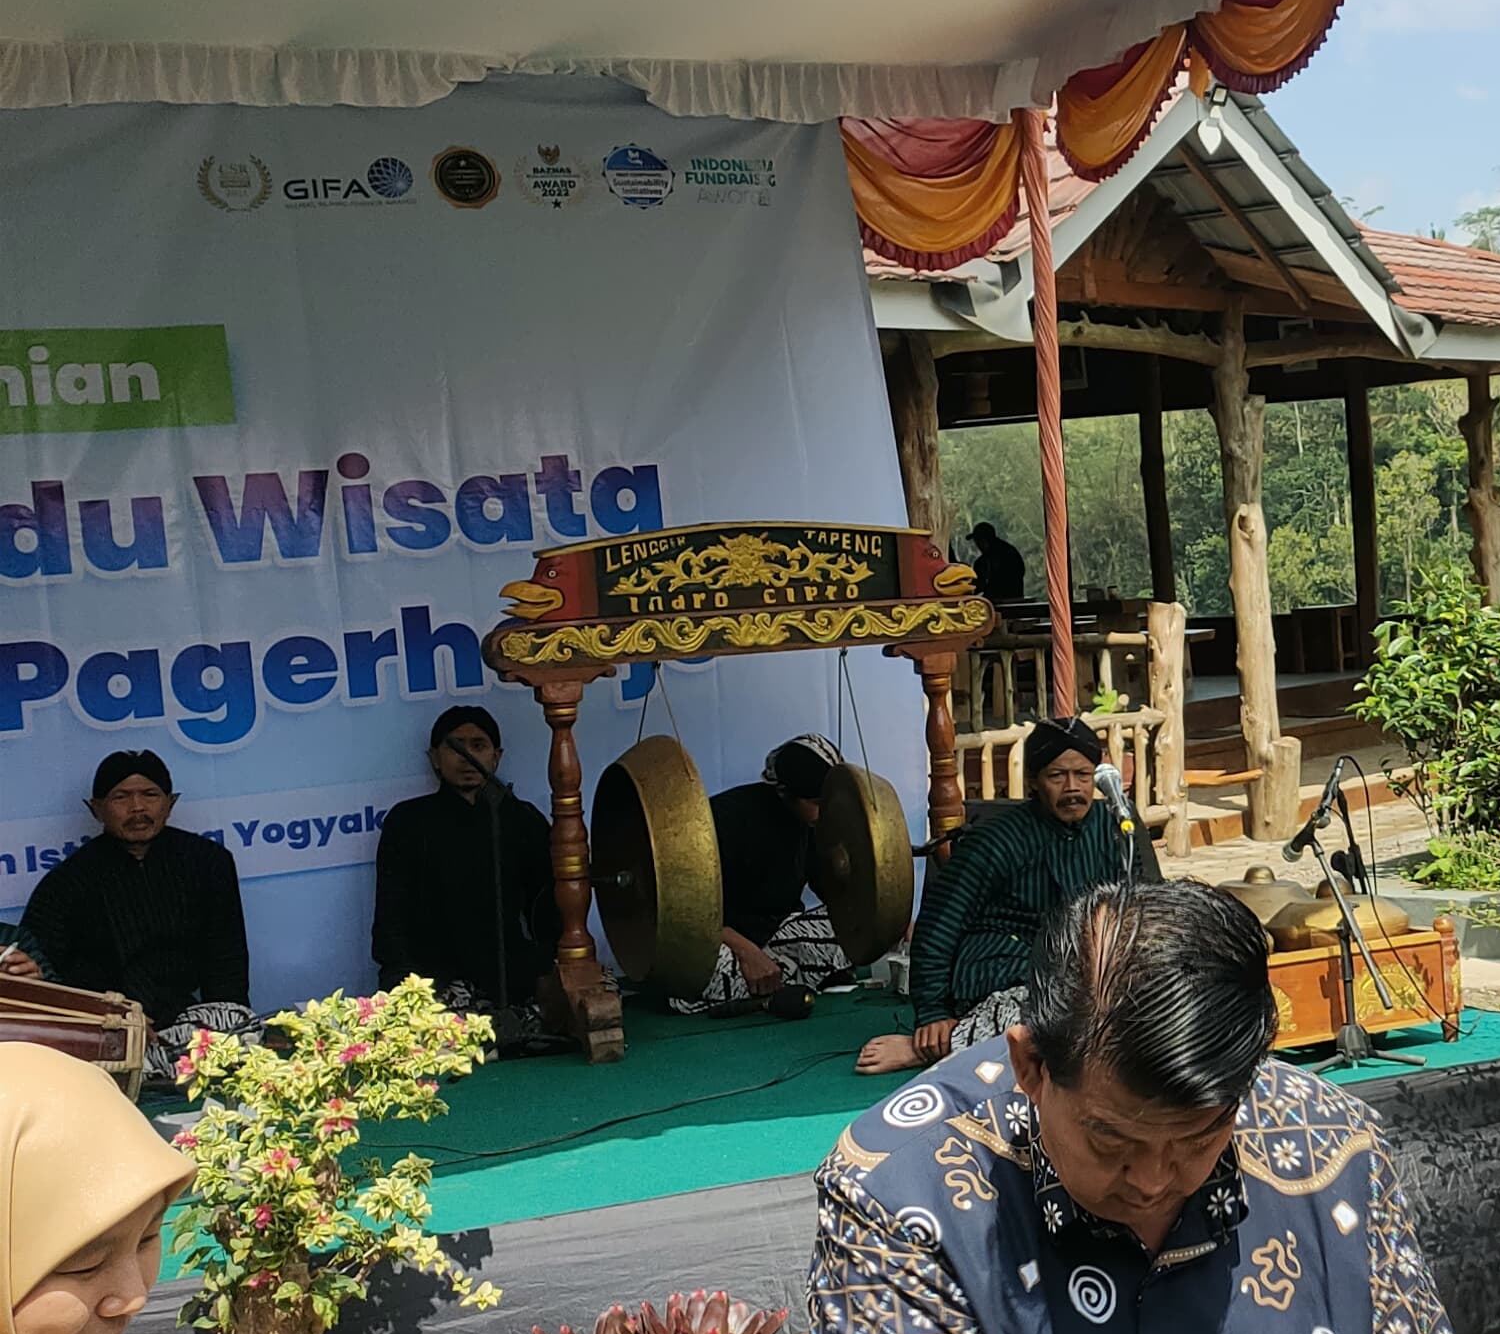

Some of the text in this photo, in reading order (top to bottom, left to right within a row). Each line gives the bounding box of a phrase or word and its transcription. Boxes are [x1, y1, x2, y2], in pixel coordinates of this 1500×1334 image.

[283, 178, 371, 200] GIFA
[532, 180, 577, 190] AWARD
[541, 188, 570, 197] 2022
[193, 452, 664, 563] Wisata
[803, 530, 882, 558] TAPENG
[231, 806, 388, 849] Yogyak
